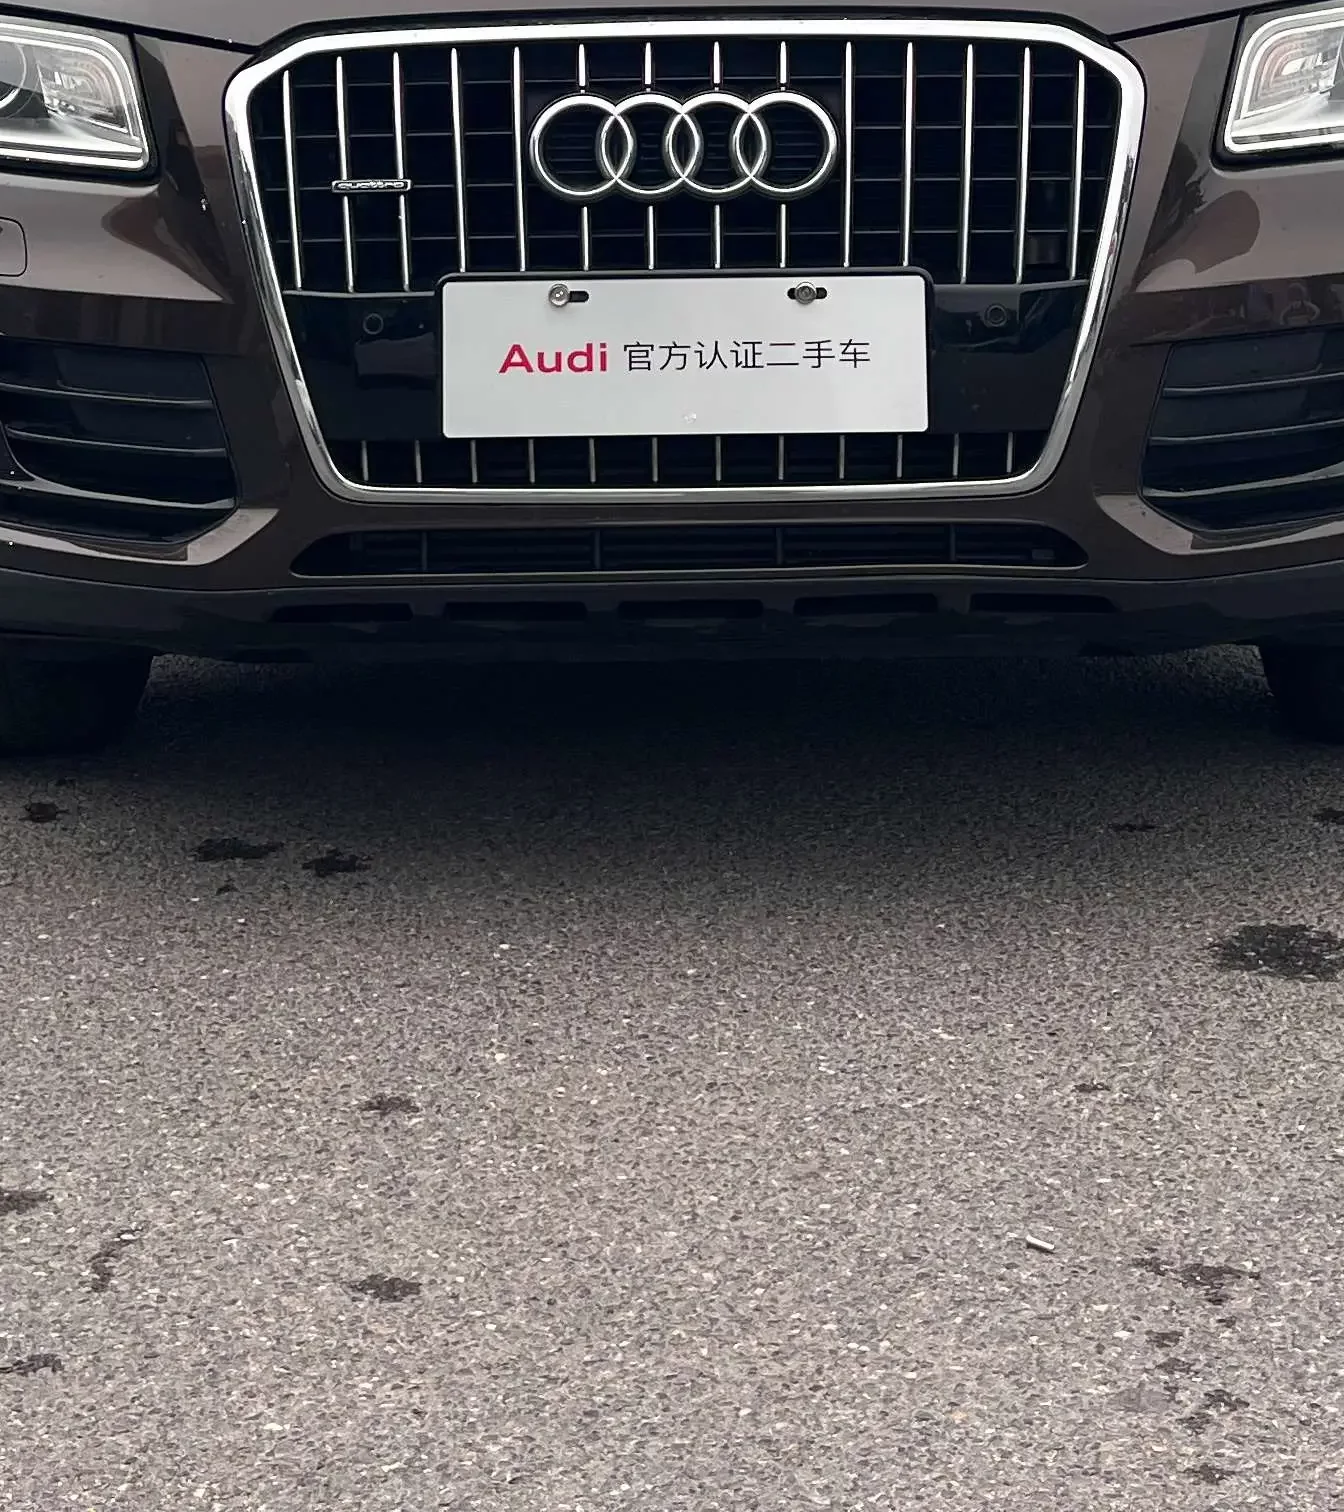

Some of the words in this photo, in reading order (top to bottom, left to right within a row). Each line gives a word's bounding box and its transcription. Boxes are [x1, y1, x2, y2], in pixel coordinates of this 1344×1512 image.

[499, 342, 607, 373] Audi
[623, 338, 871, 372] 官方认证二手车
